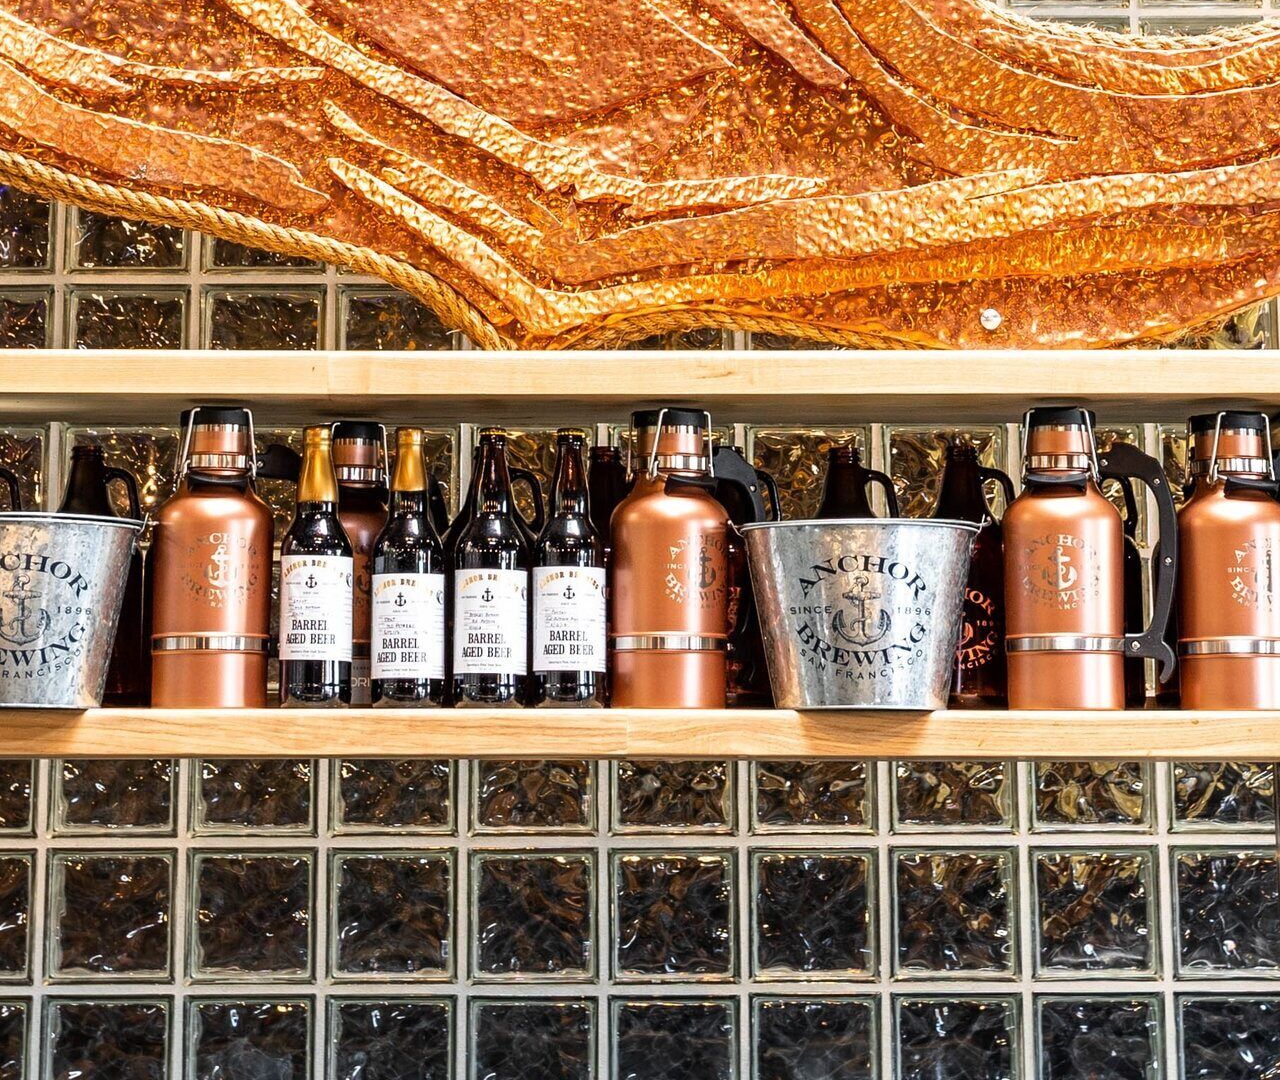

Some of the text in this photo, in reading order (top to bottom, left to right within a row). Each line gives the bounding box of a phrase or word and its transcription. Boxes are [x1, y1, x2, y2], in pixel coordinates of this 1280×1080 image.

[798, 554, 927, 601] ANCHOR
[56, 606, 93, 615] 1896
[789, 605, 931, 616] SINCE 1896
[286, 633, 336, 645] AGED BEER
[549, 630, 588, 641] BARREL
[382, 638, 420, 650] BARREL
[543, 644, 594, 655] AGED BEER
[795, 620, 927, 667] BREWING
[377, 652, 427, 663] AGED BEER
[462, 646, 512, 658] AGED BEER
[800, 648, 827, 671] SAN
